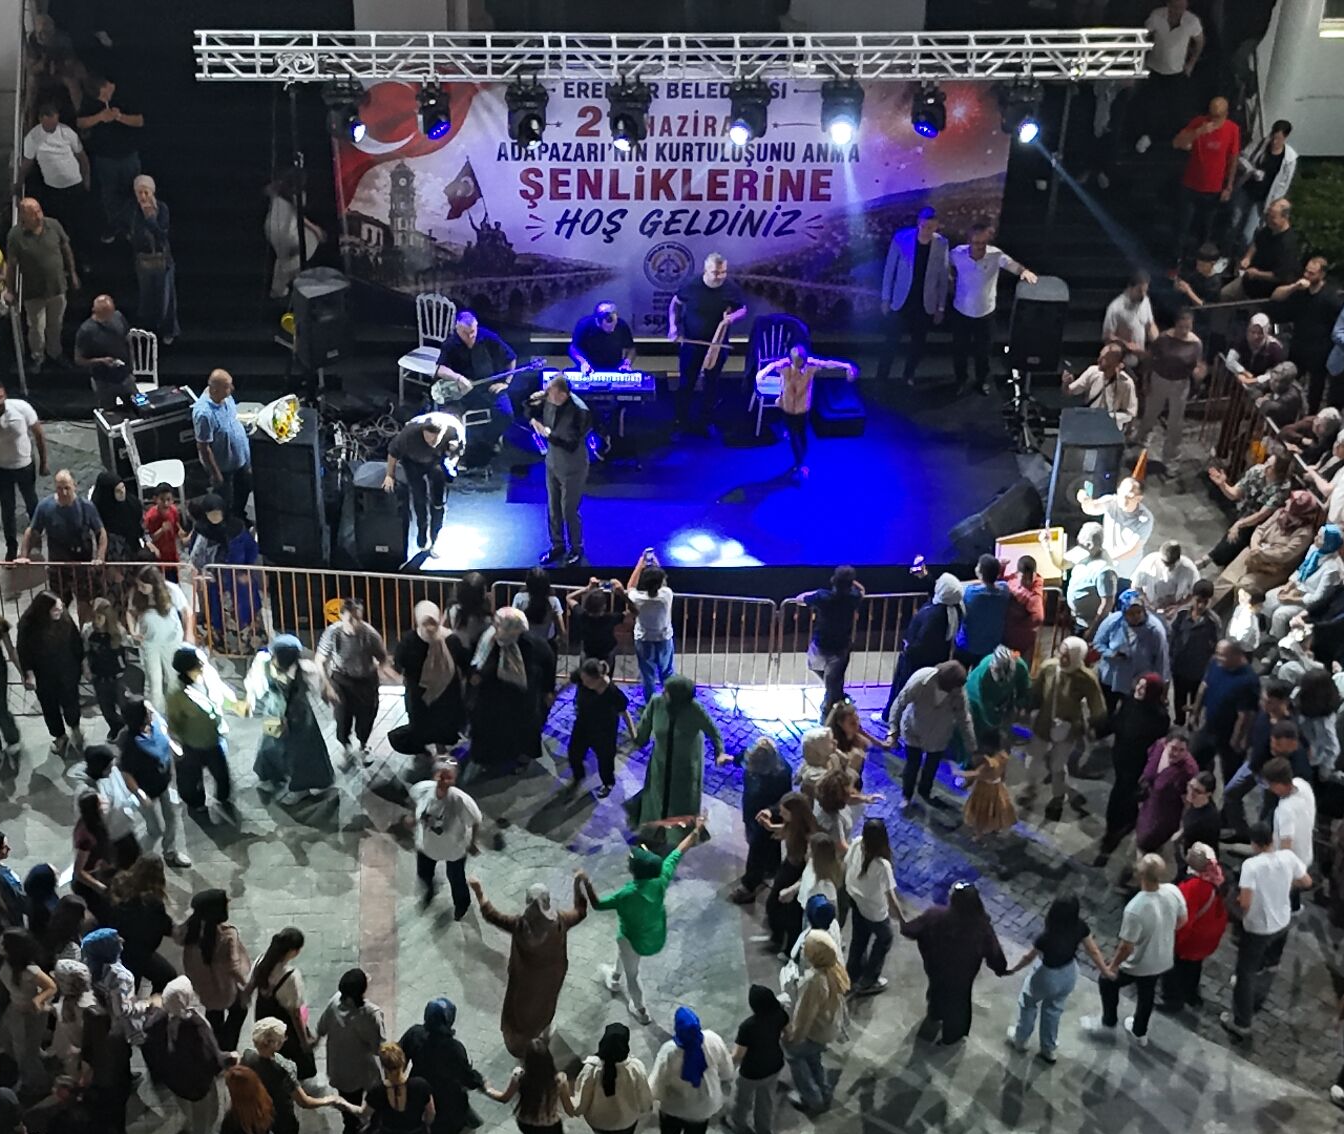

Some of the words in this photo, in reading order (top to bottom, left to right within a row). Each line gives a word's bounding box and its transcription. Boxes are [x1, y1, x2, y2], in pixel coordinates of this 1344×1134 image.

[563, 82, 660, 99] ERER
[575, 105, 609, 137] 2
[645, 110, 732, 137] HAZİRA
[656, 142, 796, 167] KURTULUŞUNU
[802, 142, 860, 163] ANMA
[519, 165, 833, 209] ŞENLİKLERİNE
[554, 208, 629, 243] HOŞ
[639, 203, 803, 239] GELDİNİZ
